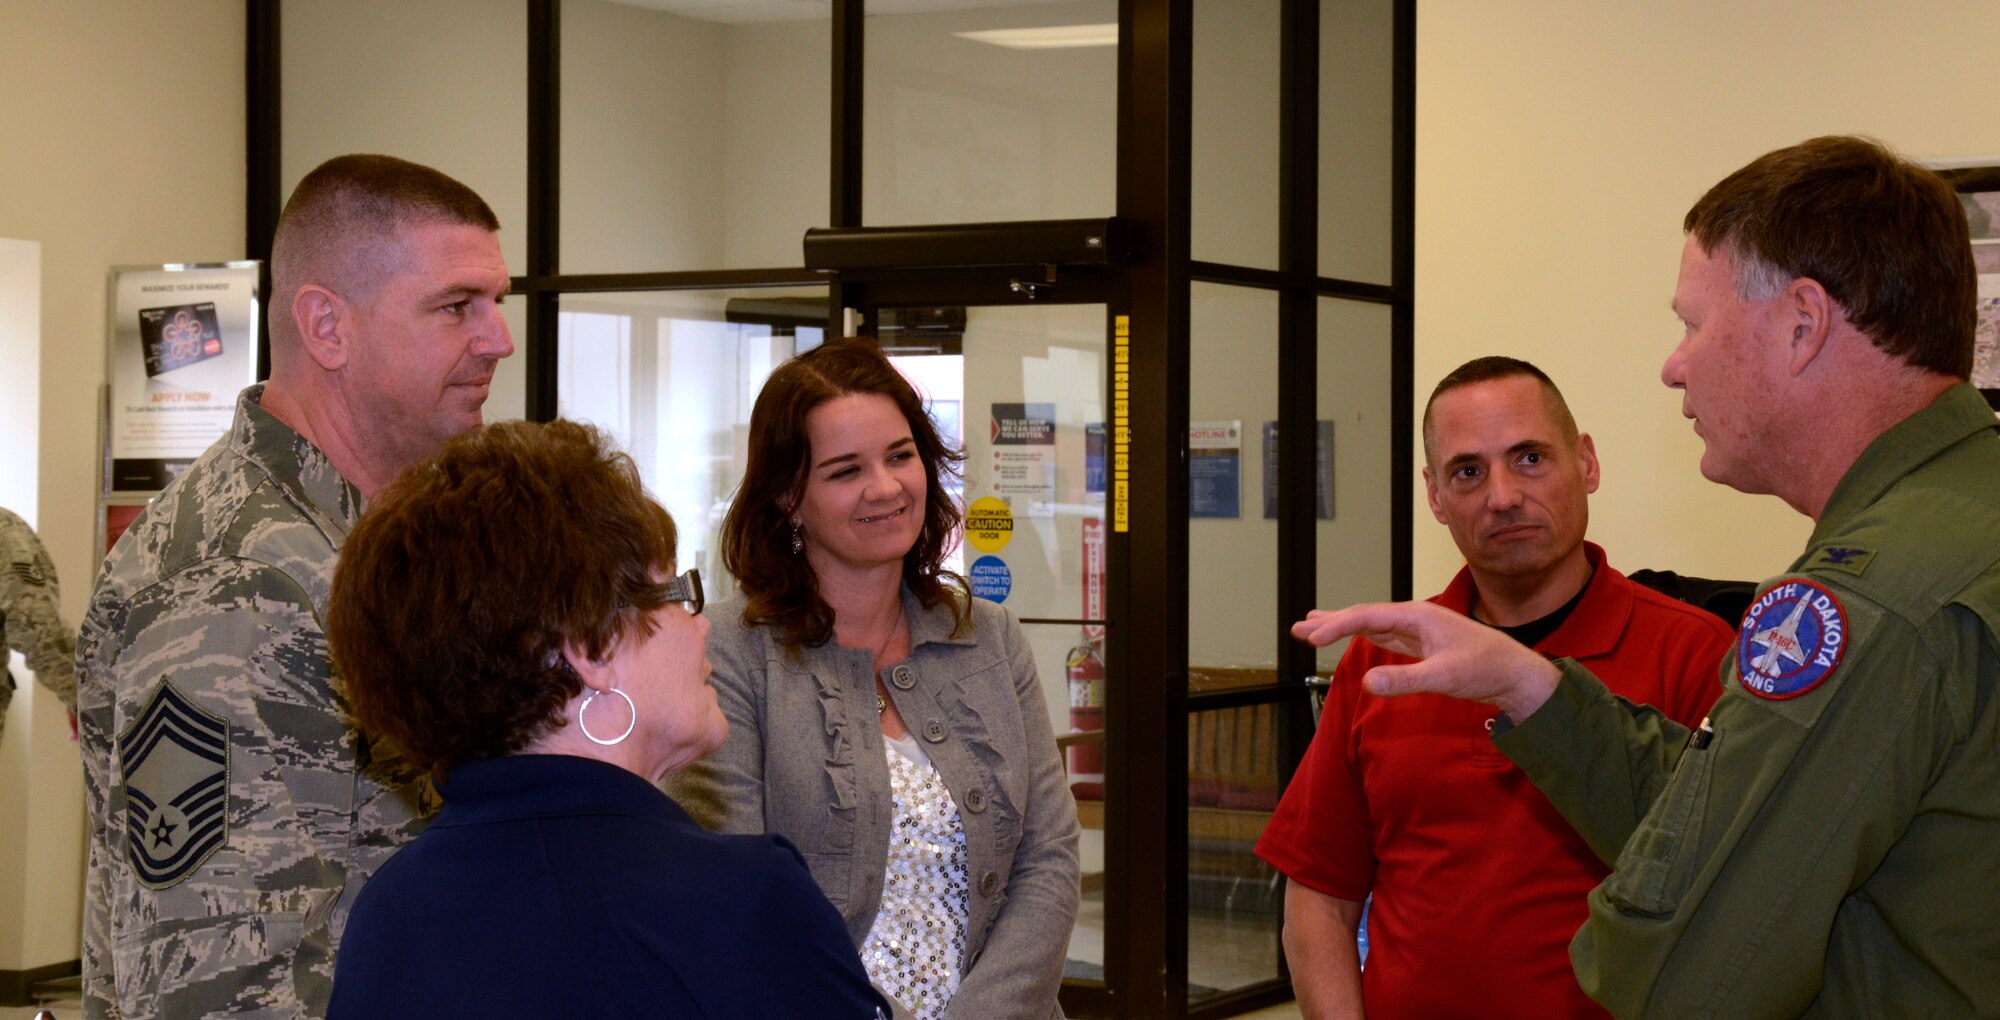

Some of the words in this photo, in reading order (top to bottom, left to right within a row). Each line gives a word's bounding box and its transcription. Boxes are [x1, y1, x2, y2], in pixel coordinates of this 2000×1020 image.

[177, 284, 195, 292] YOUR
[151, 392, 183, 402] APPLY
[185, 392, 212, 402] NOW
[1029, 418, 1046, 426] HOW
[969, 509, 1010, 517] AUTOMATIC
[968, 519, 1012, 530] CAUTION
[979, 532, 999, 540] DOOR
[973, 565, 1009, 575] ACTIVATE
[1001, 576, 1011, 586] TO
[973, 586, 1008, 596] OPERATE
[1743, 583, 1798, 630] SOUTH
[1812, 594, 1842, 668] DAKOTA
[1743, 671, 1775, 693] ANG
